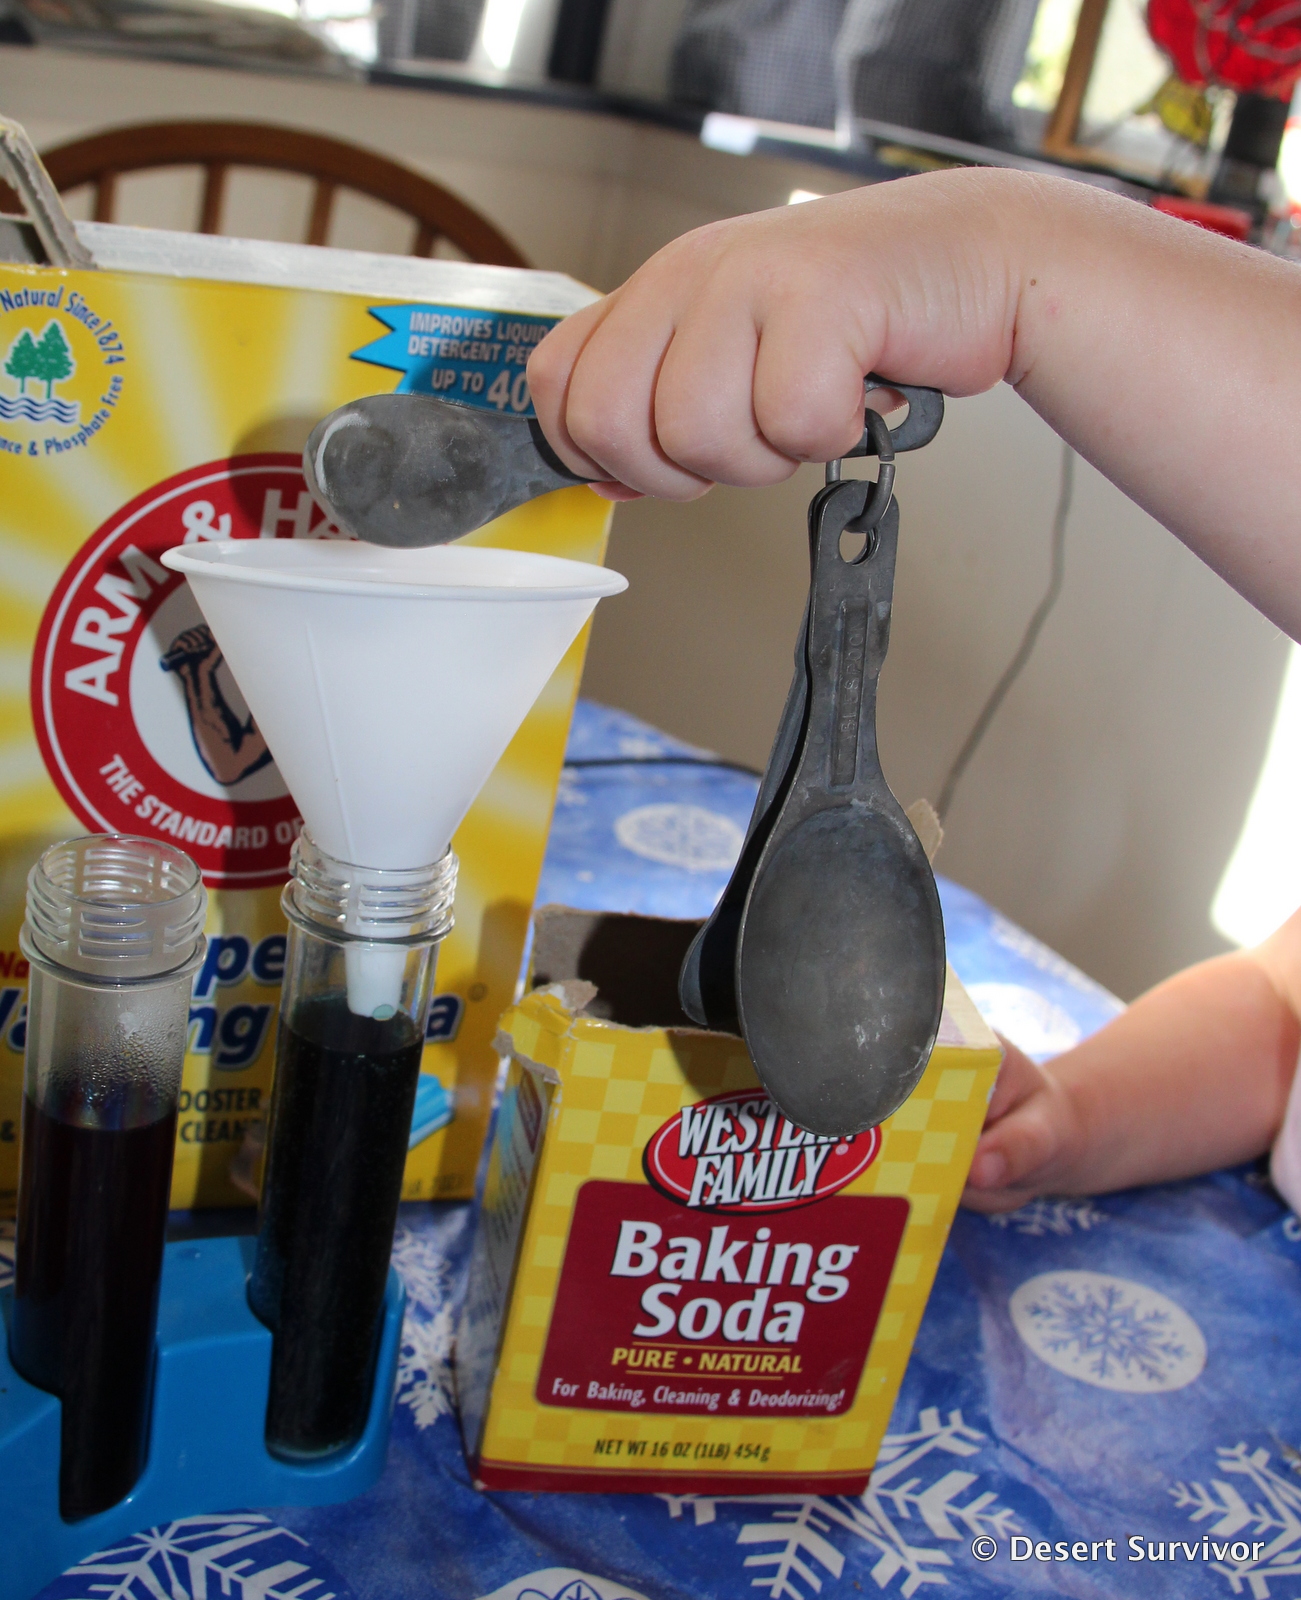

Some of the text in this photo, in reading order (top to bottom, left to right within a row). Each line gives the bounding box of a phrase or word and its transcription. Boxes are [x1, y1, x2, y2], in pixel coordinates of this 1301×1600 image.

[0, 285, 126, 365] Natural Since 1874
[407, 335, 501, 363] DETERGENT
[409, 311, 549, 343] IMPROVES LIQUID
[43, 408, 111, 455] Phosphate
[102, 375, 124, 406] Free
[431, 367, 531, 413] UP TO 40
[64, 499, 234, 707] ARM &
[99, 753, 145, 805] THE
[134, 794, 269, 849] STANDARD
[178, 1087, 262, 1112] OOSTER
[678, 1100, 855, 1158] WEST
[686, 1144, 831, 1208] FAMILY
[609, 1220, 860, 1304] Baking
[632, 1282, 806, 1344] Soda
[611, 1347, 804, 1374] PURE NATURAL
[552, 1378, 846, 1412] For Baking, Cleaning & Deodorizing!
[594, 1439, 771, 1463] NET WT 16 OZ (1LB) 454g
